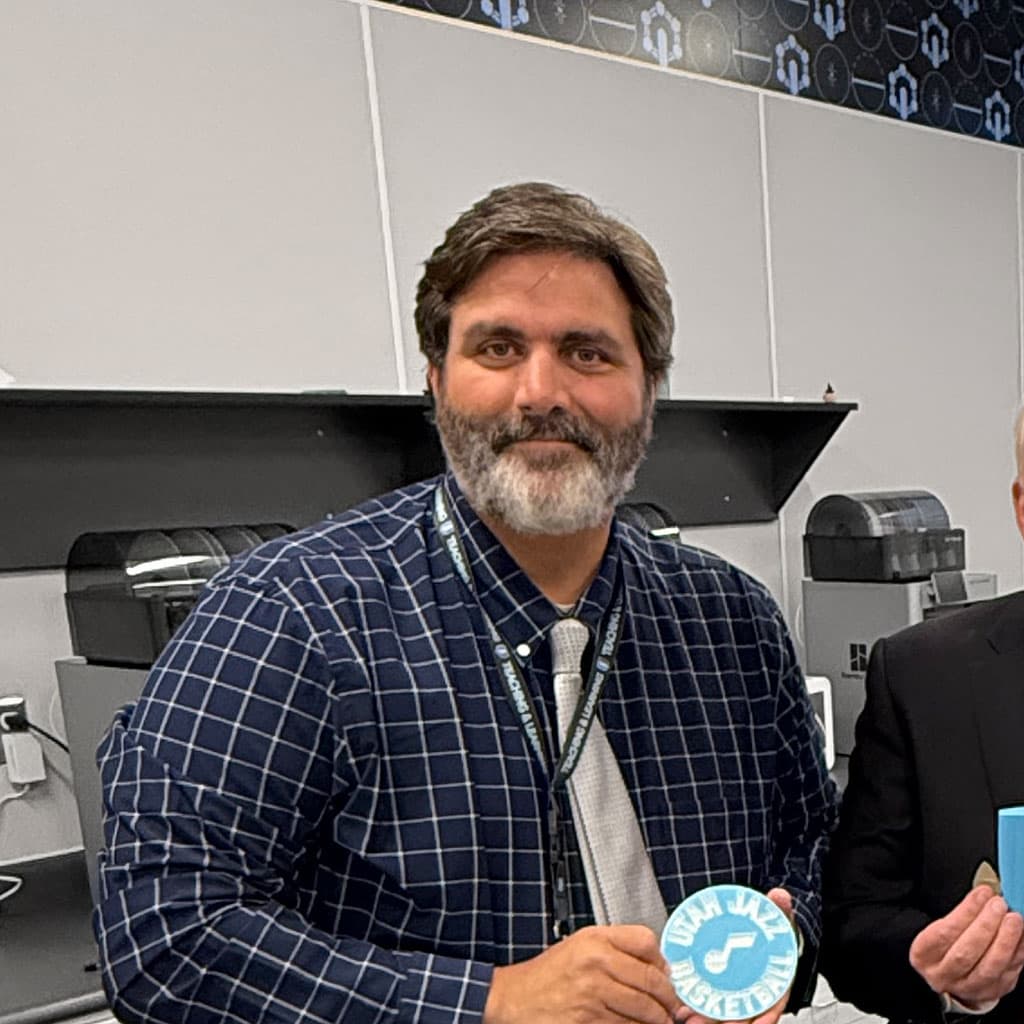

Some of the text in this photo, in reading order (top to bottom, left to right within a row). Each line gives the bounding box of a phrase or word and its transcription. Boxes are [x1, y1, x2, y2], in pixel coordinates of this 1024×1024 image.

[502, 660, 530, 714] TEACHING
[560, 726, 586, 774] TEACHING
[666, 890, 724, 947] UTAH
[669, 950, 794, 1018] BASKETBALL
